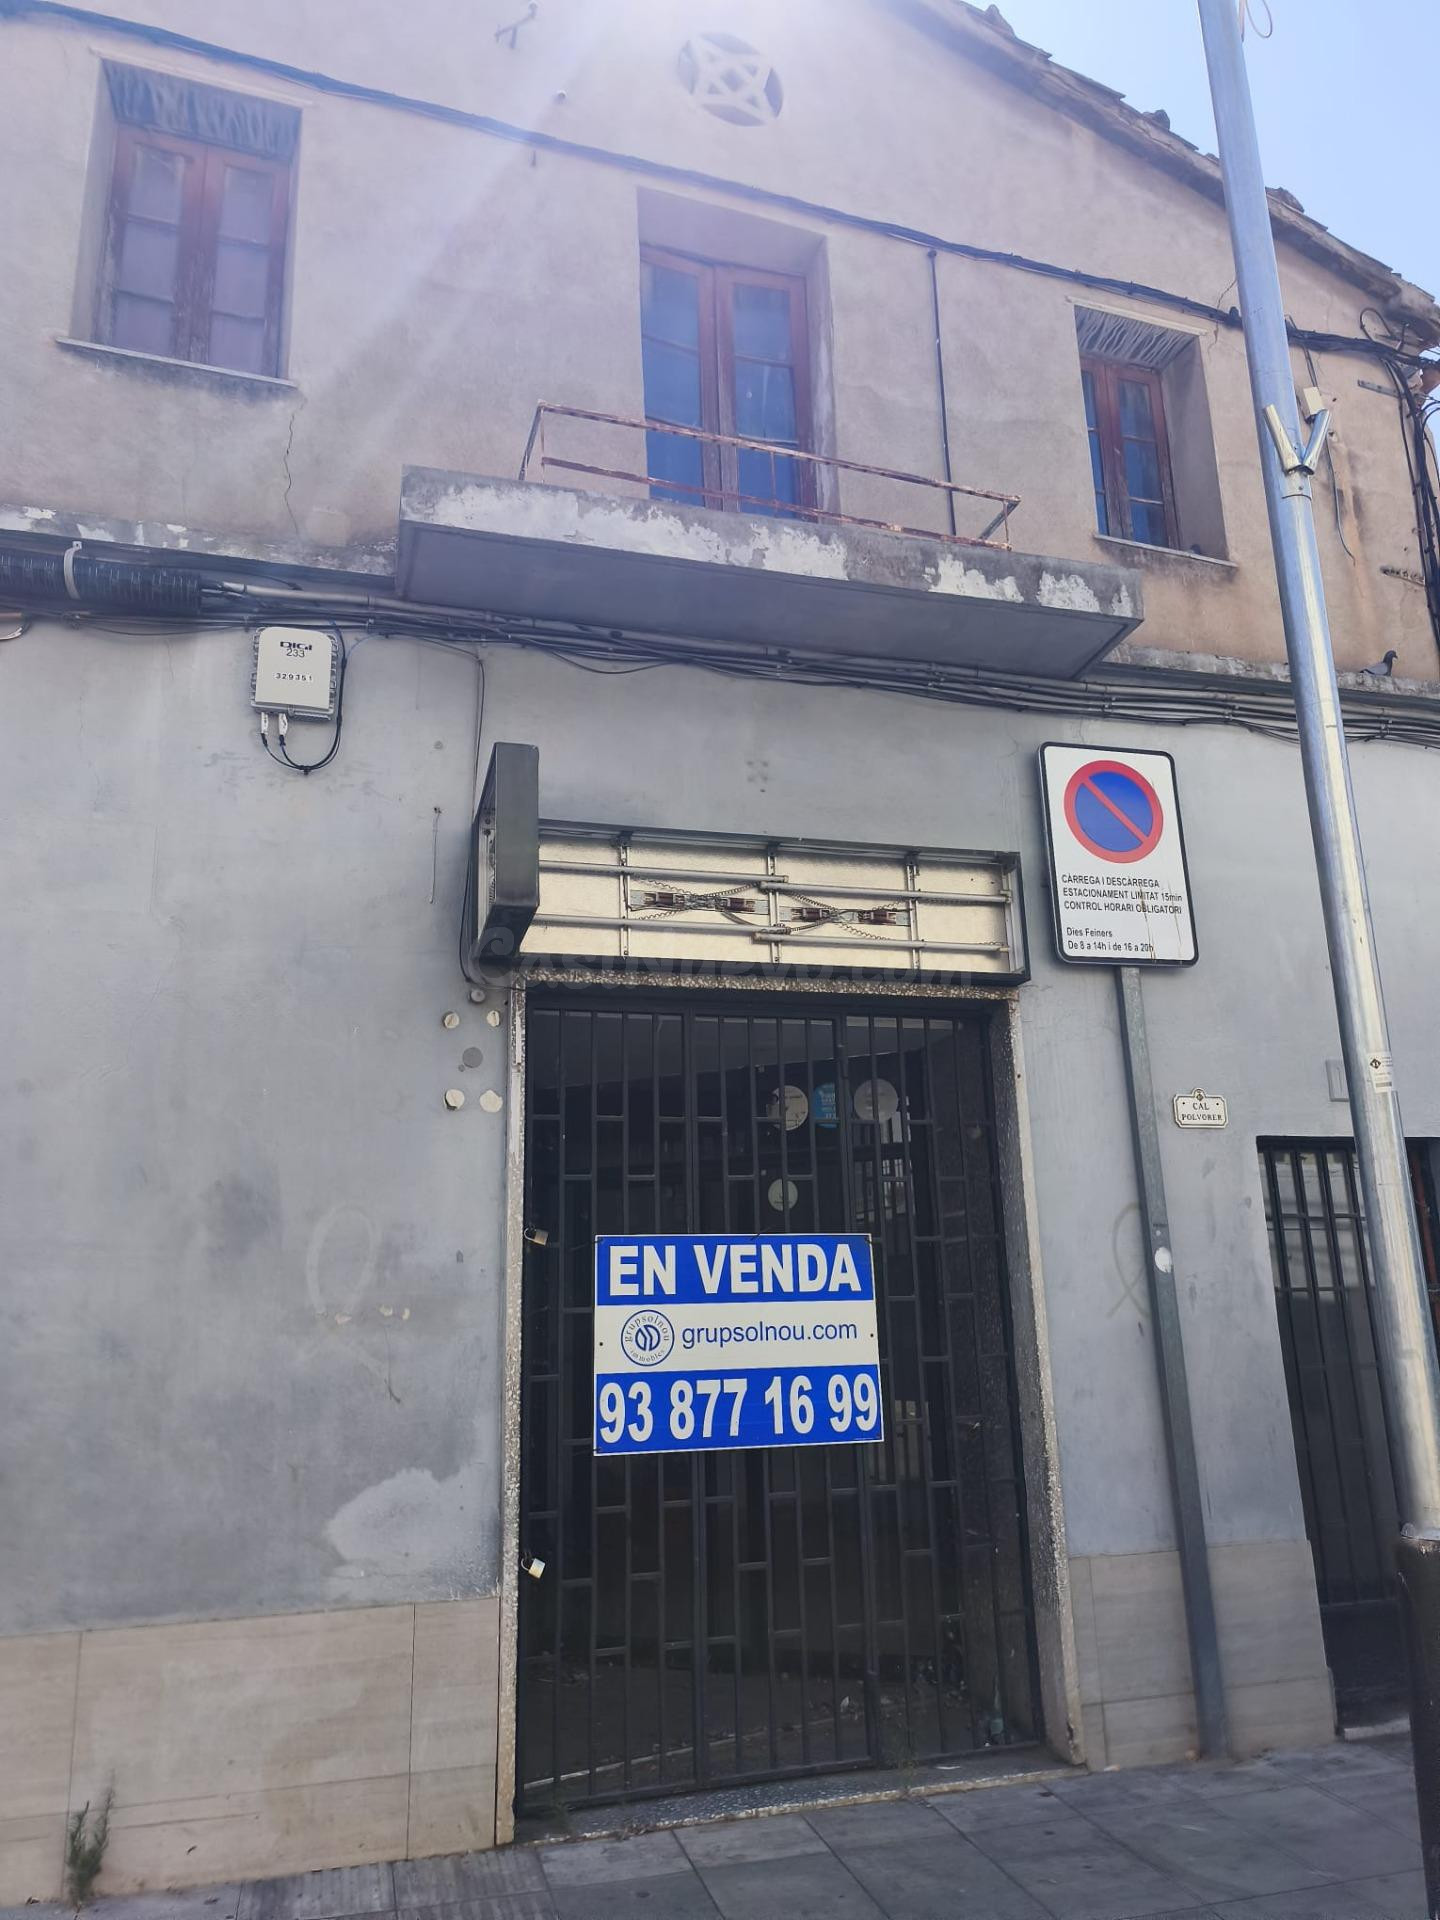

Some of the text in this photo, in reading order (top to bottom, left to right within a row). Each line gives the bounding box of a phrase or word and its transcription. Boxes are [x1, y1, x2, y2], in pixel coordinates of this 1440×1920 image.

[286, 648, 305, 658] 233
[1063, 887, 1182, 902] ESTACIONAMENT LIMITAT 15min
[1064, 900, 1182, 914] CONTROL HORARI OBLIGATORI
[1066, 926, 1113, 938] Dies Feiners
[1068, 940, 1079, 950] De
[1080, 941, 1085, 950] 8
[1086, 943, 1092, 951] a
[1093, 941, 1107, 951] 14h
[1112, 942, 1122, 951] de
[1124, 942, 1133, 952] 16
[1140, 943, 1154, 953] 20h
[1192, 1102, 1210, 1111] CAL
[1181, 1113, 1223, 1121] POLVORER
[609, 1243, 862, 1296] EN VENDA
[682, 1321, 857, 1349] grupsolnou.com
[599, 1373, 877, 1443] 93 877 16 99
